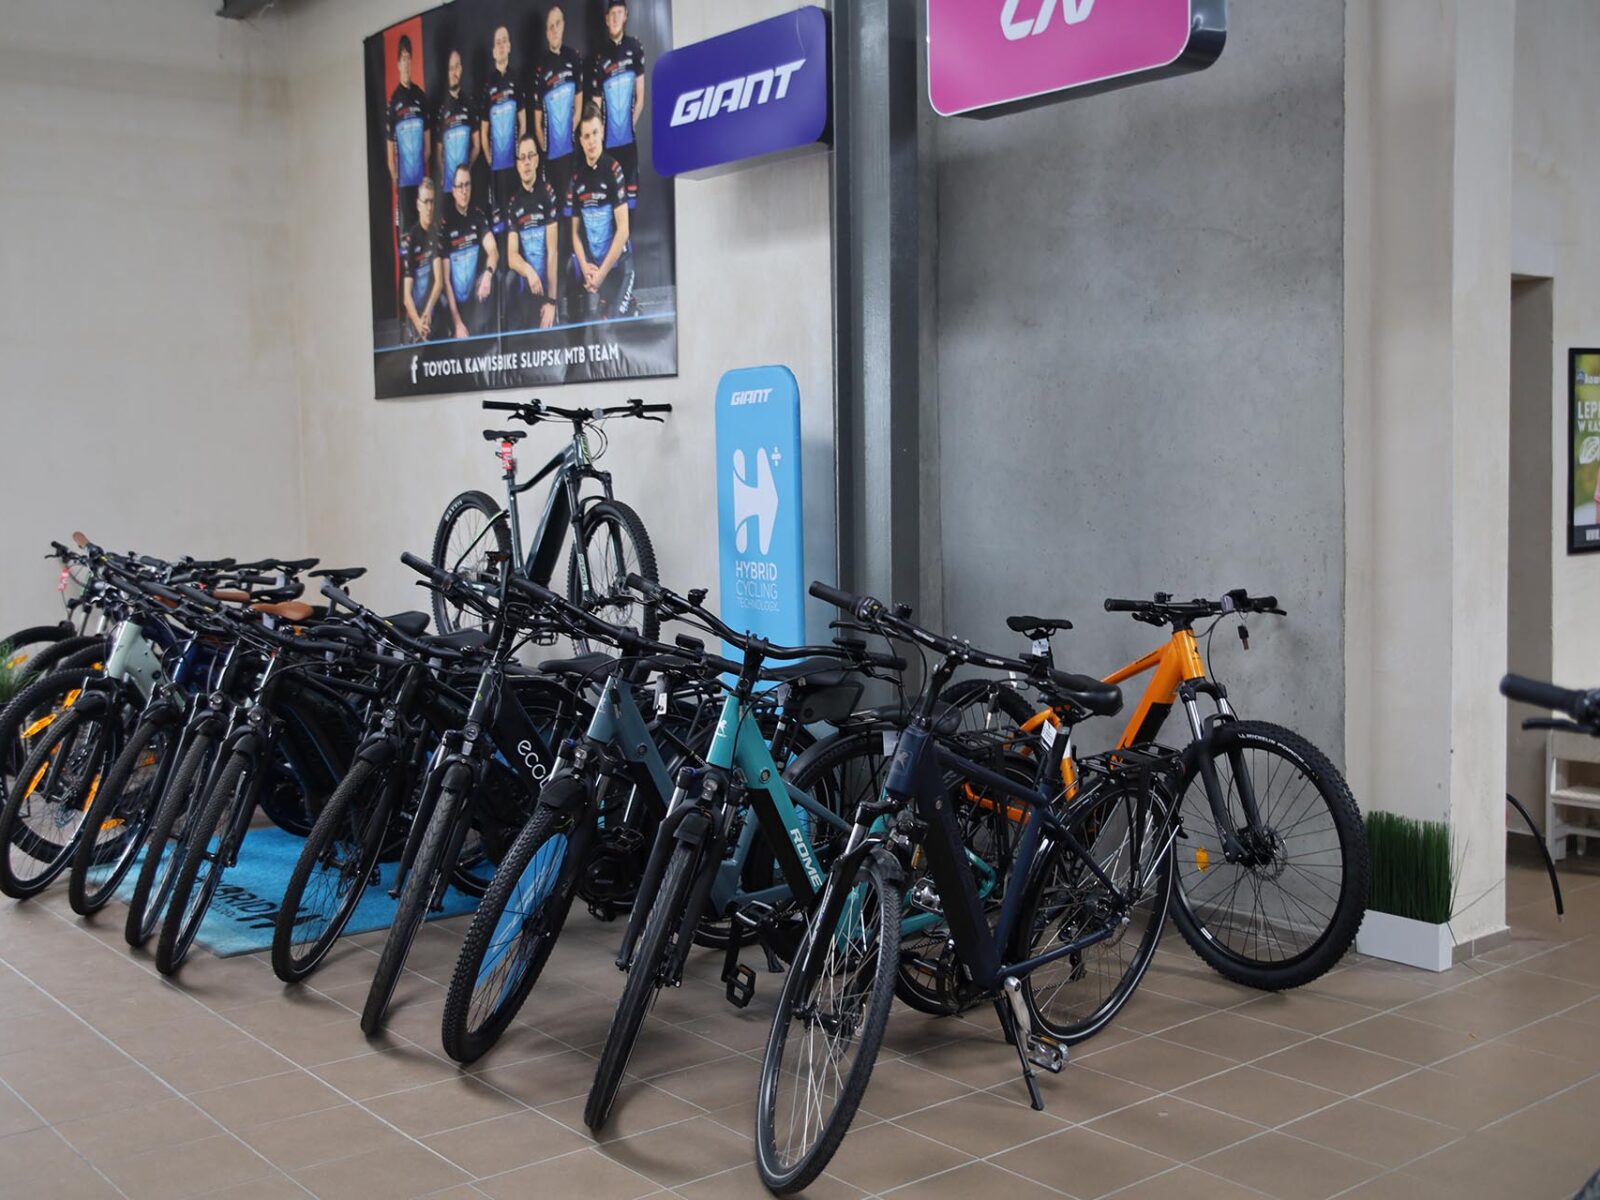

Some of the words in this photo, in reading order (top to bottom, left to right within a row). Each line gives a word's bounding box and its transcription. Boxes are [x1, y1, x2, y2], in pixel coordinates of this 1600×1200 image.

[670, 58, 806, 127] GIANT
[422, 359, 463, 377] TOYOTA
[465, 354, 518, 373] KAWISBIKE
[520, 349, 562, 368] SLUPSK
[565, 346, 586, 364] MTB
[588, 343, 620, 361] TEAM
[730, 388, 773, 406] GIANT
[735, 560, 778, 581] HYBRID
[735, 579, 778, 600] CYCLING
[789, 828, 823, 887] ROME
